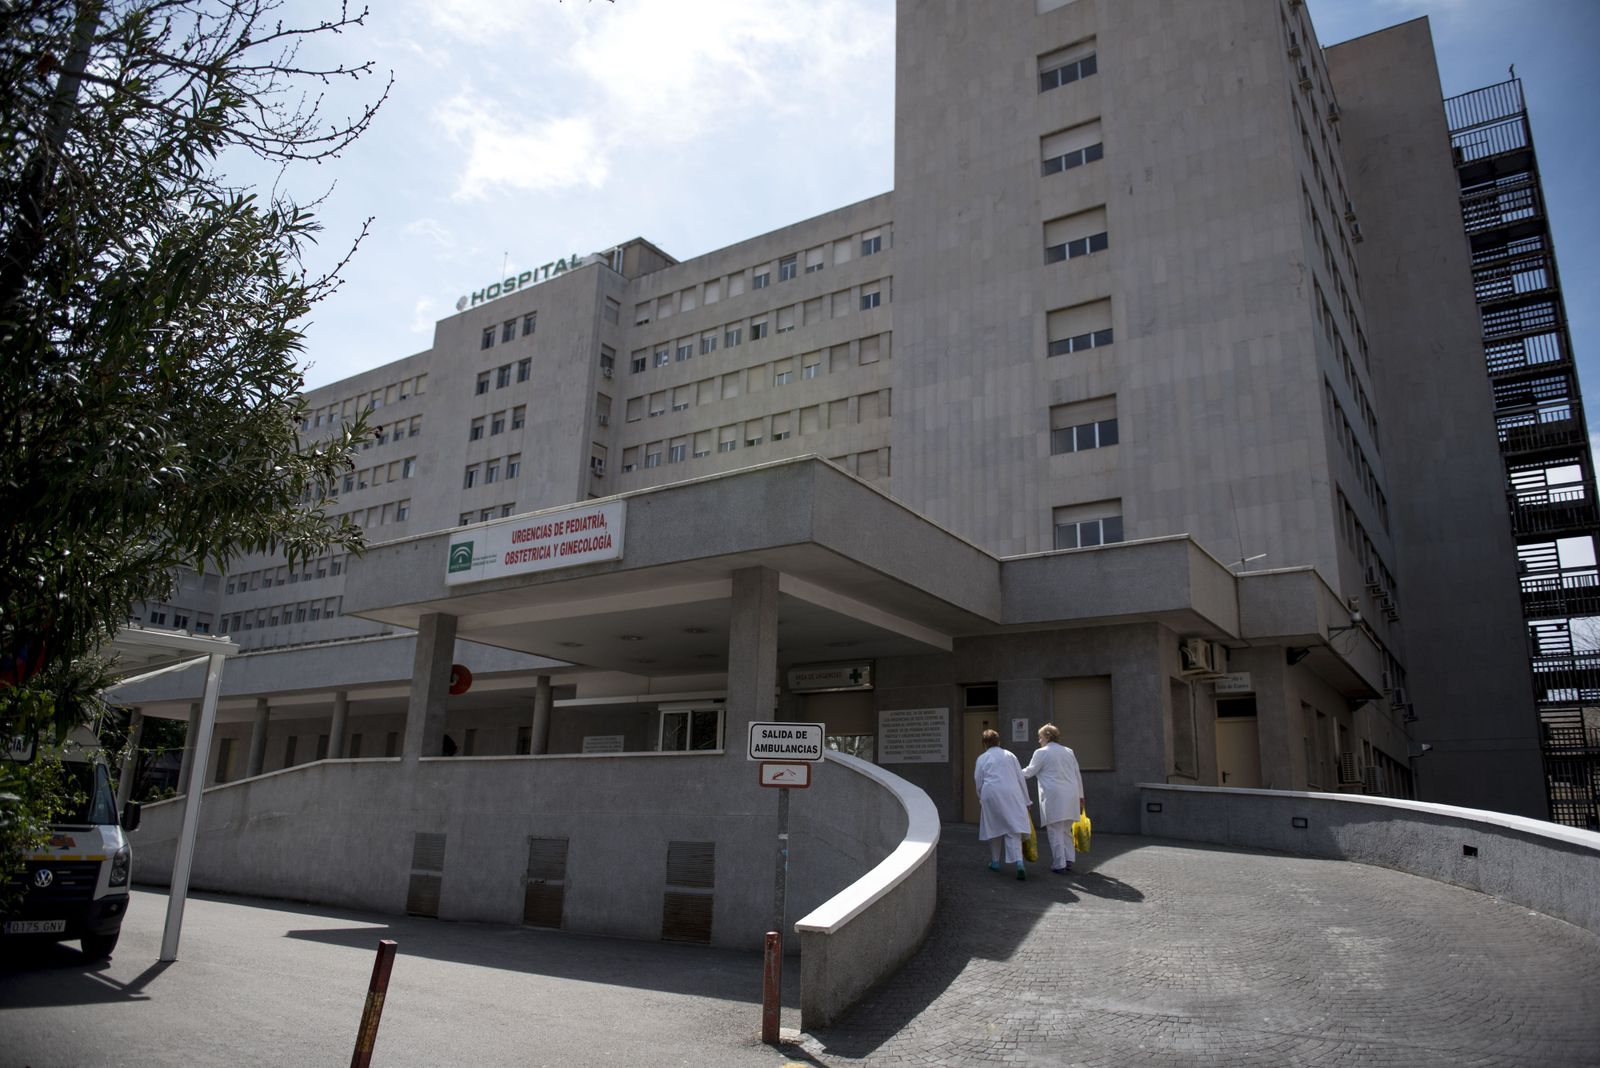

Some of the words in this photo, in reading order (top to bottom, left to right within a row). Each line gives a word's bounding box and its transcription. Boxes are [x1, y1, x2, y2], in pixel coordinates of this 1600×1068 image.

[470, 253, 584, 306] HOSPITAL
[511, 523, 553, 545] URGENCIAS
[553, 522, 564, 537] DE
[565, 510, 608, 534] PEDIATRÍA,
[504, 545, 551, 566] OBSTETRICIA
[553, 544, 558, 557] Y
[559, 531, 612, 556] GINECOLOGÍA
[754, 743, 818, 754] AMBULANCIAS
[762, 729, 793, 739] SALIDA
[795, 730, 808, 739] DE
